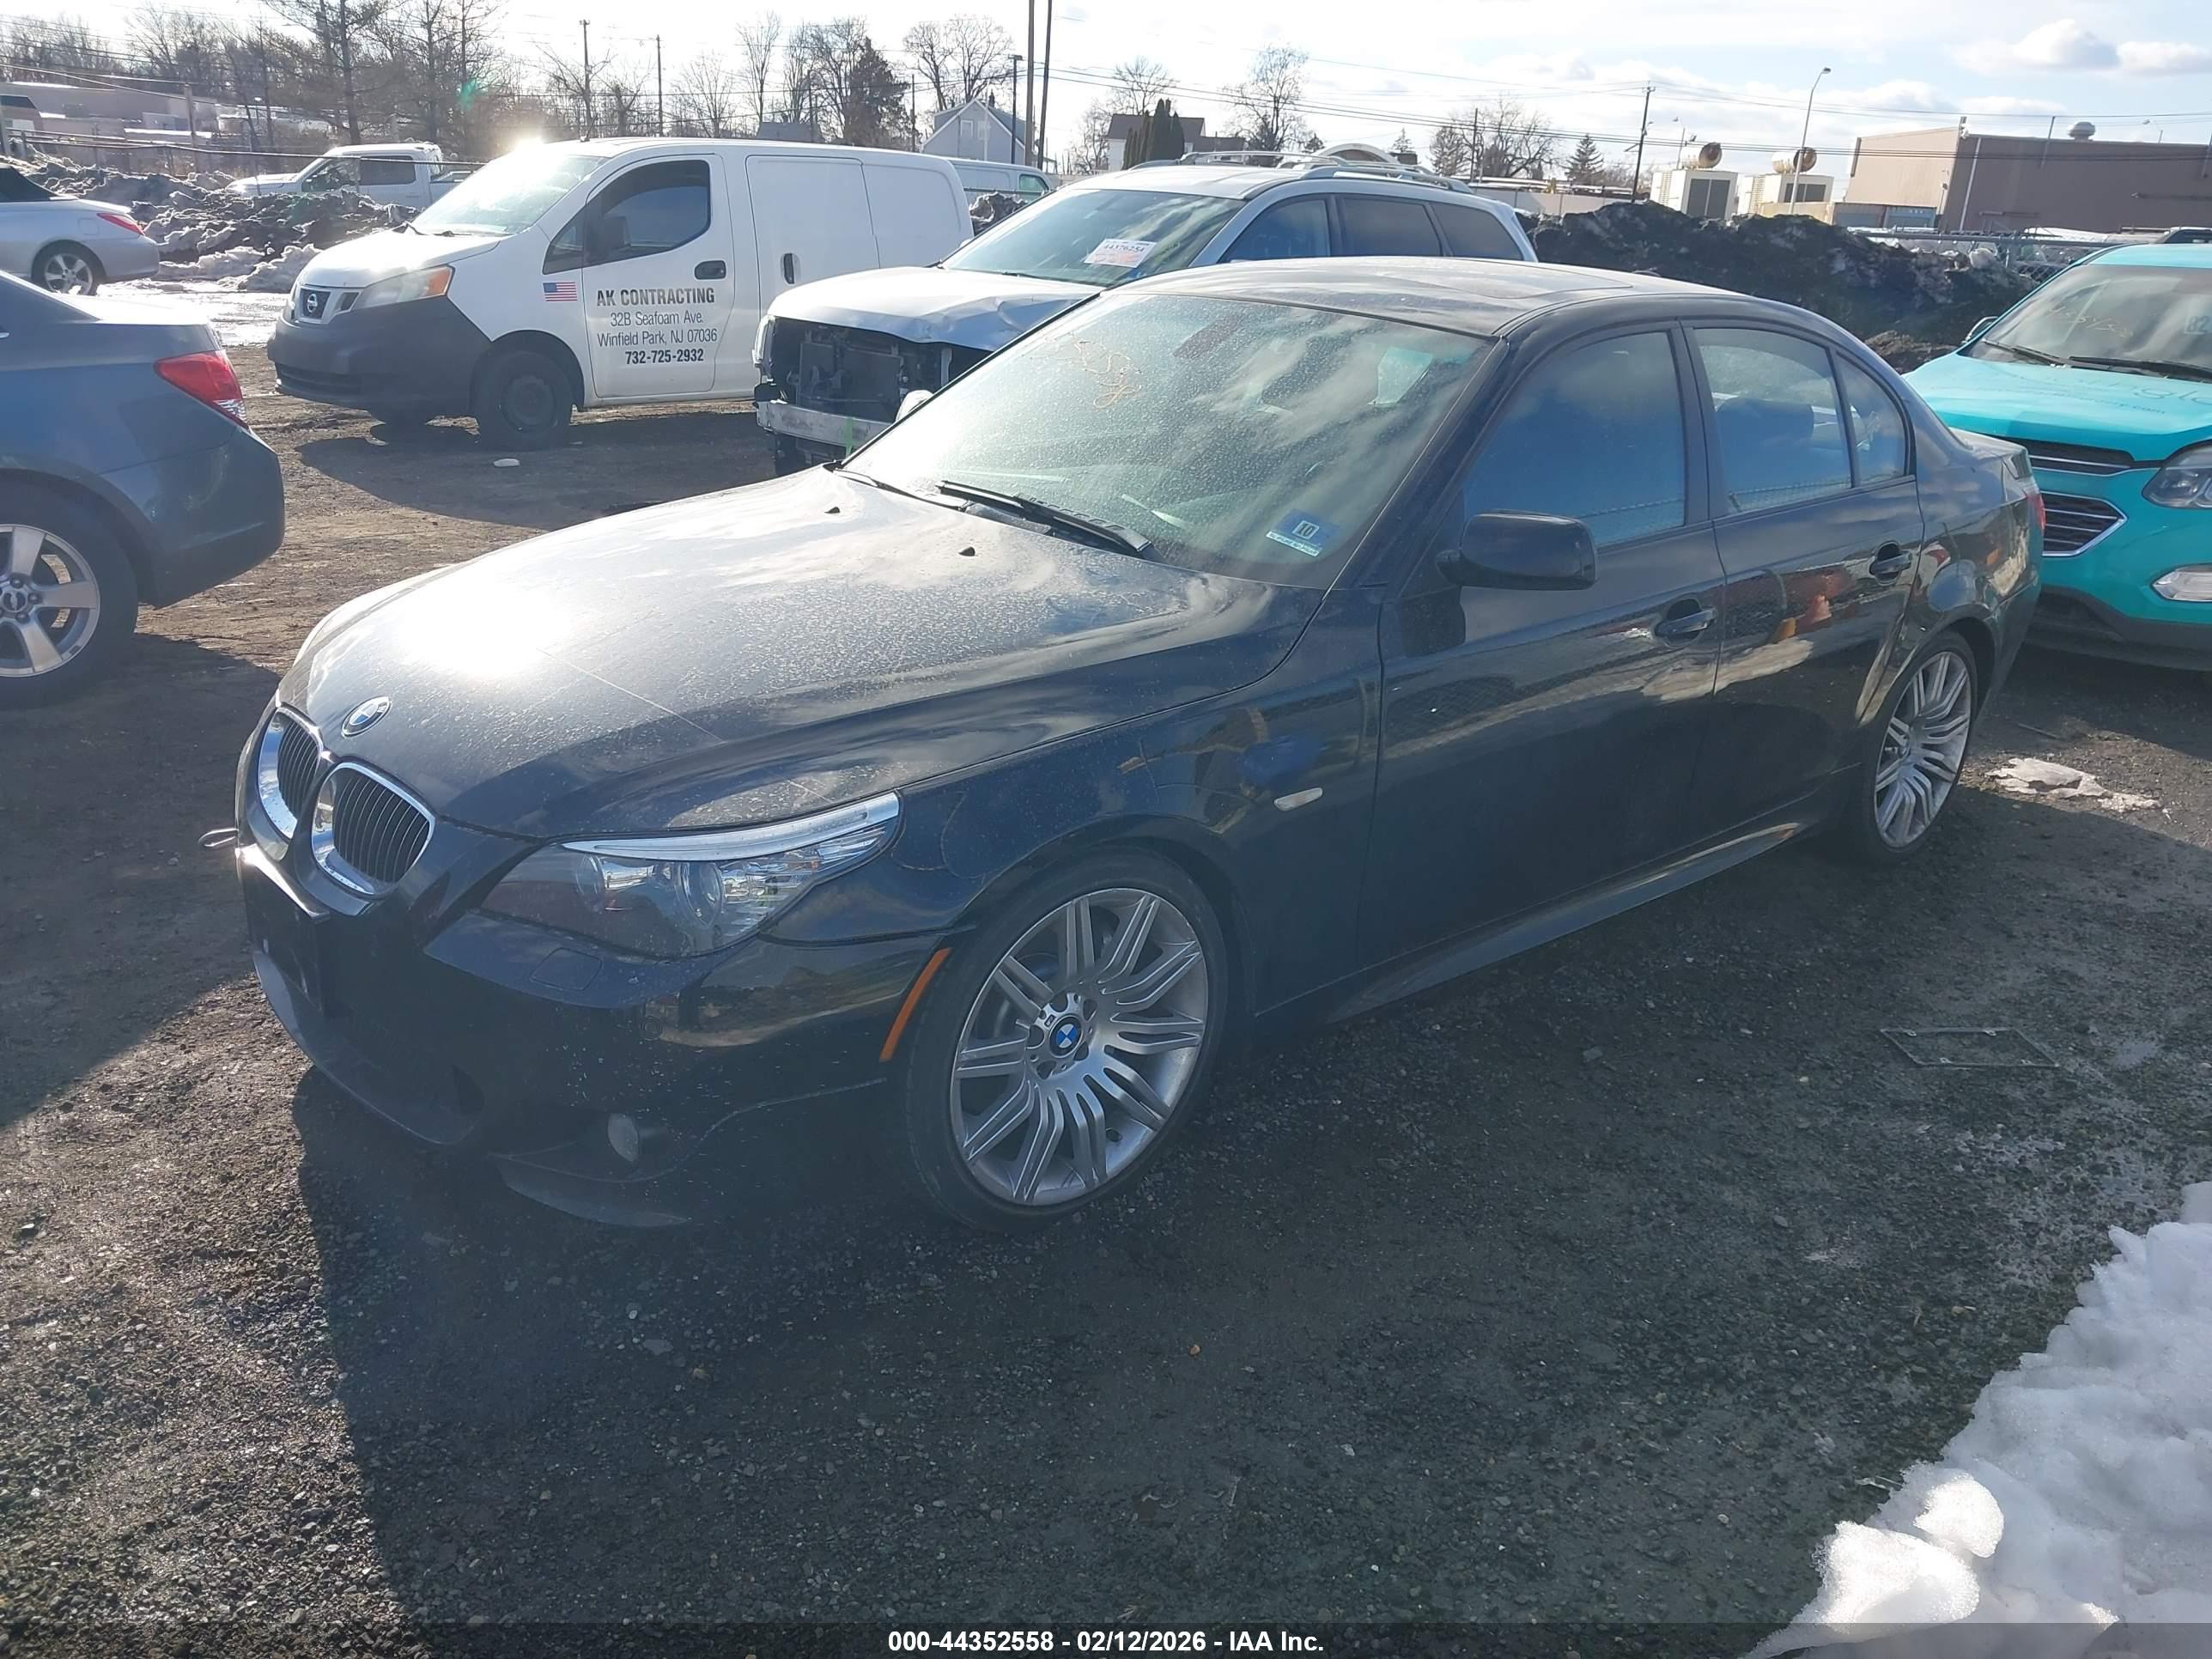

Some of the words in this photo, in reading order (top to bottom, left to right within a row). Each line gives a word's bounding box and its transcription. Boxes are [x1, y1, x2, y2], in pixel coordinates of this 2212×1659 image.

[597, 289, 616, 307] AK
[621, 288, 714, 305] CONTRACTING
[611, 312, 632, 327] 32B
[635, 312, 679, 326] Seafoam
[684, 310, 703, 324] Ave.
[597, 331, 638, 347] Winfield
[642, 331, 667, 346] Park,
[671, 330, 684, 343] NJ
[687, 329, 717, 343] 07036
[625, 349, 704, 364] 732-725-2932
